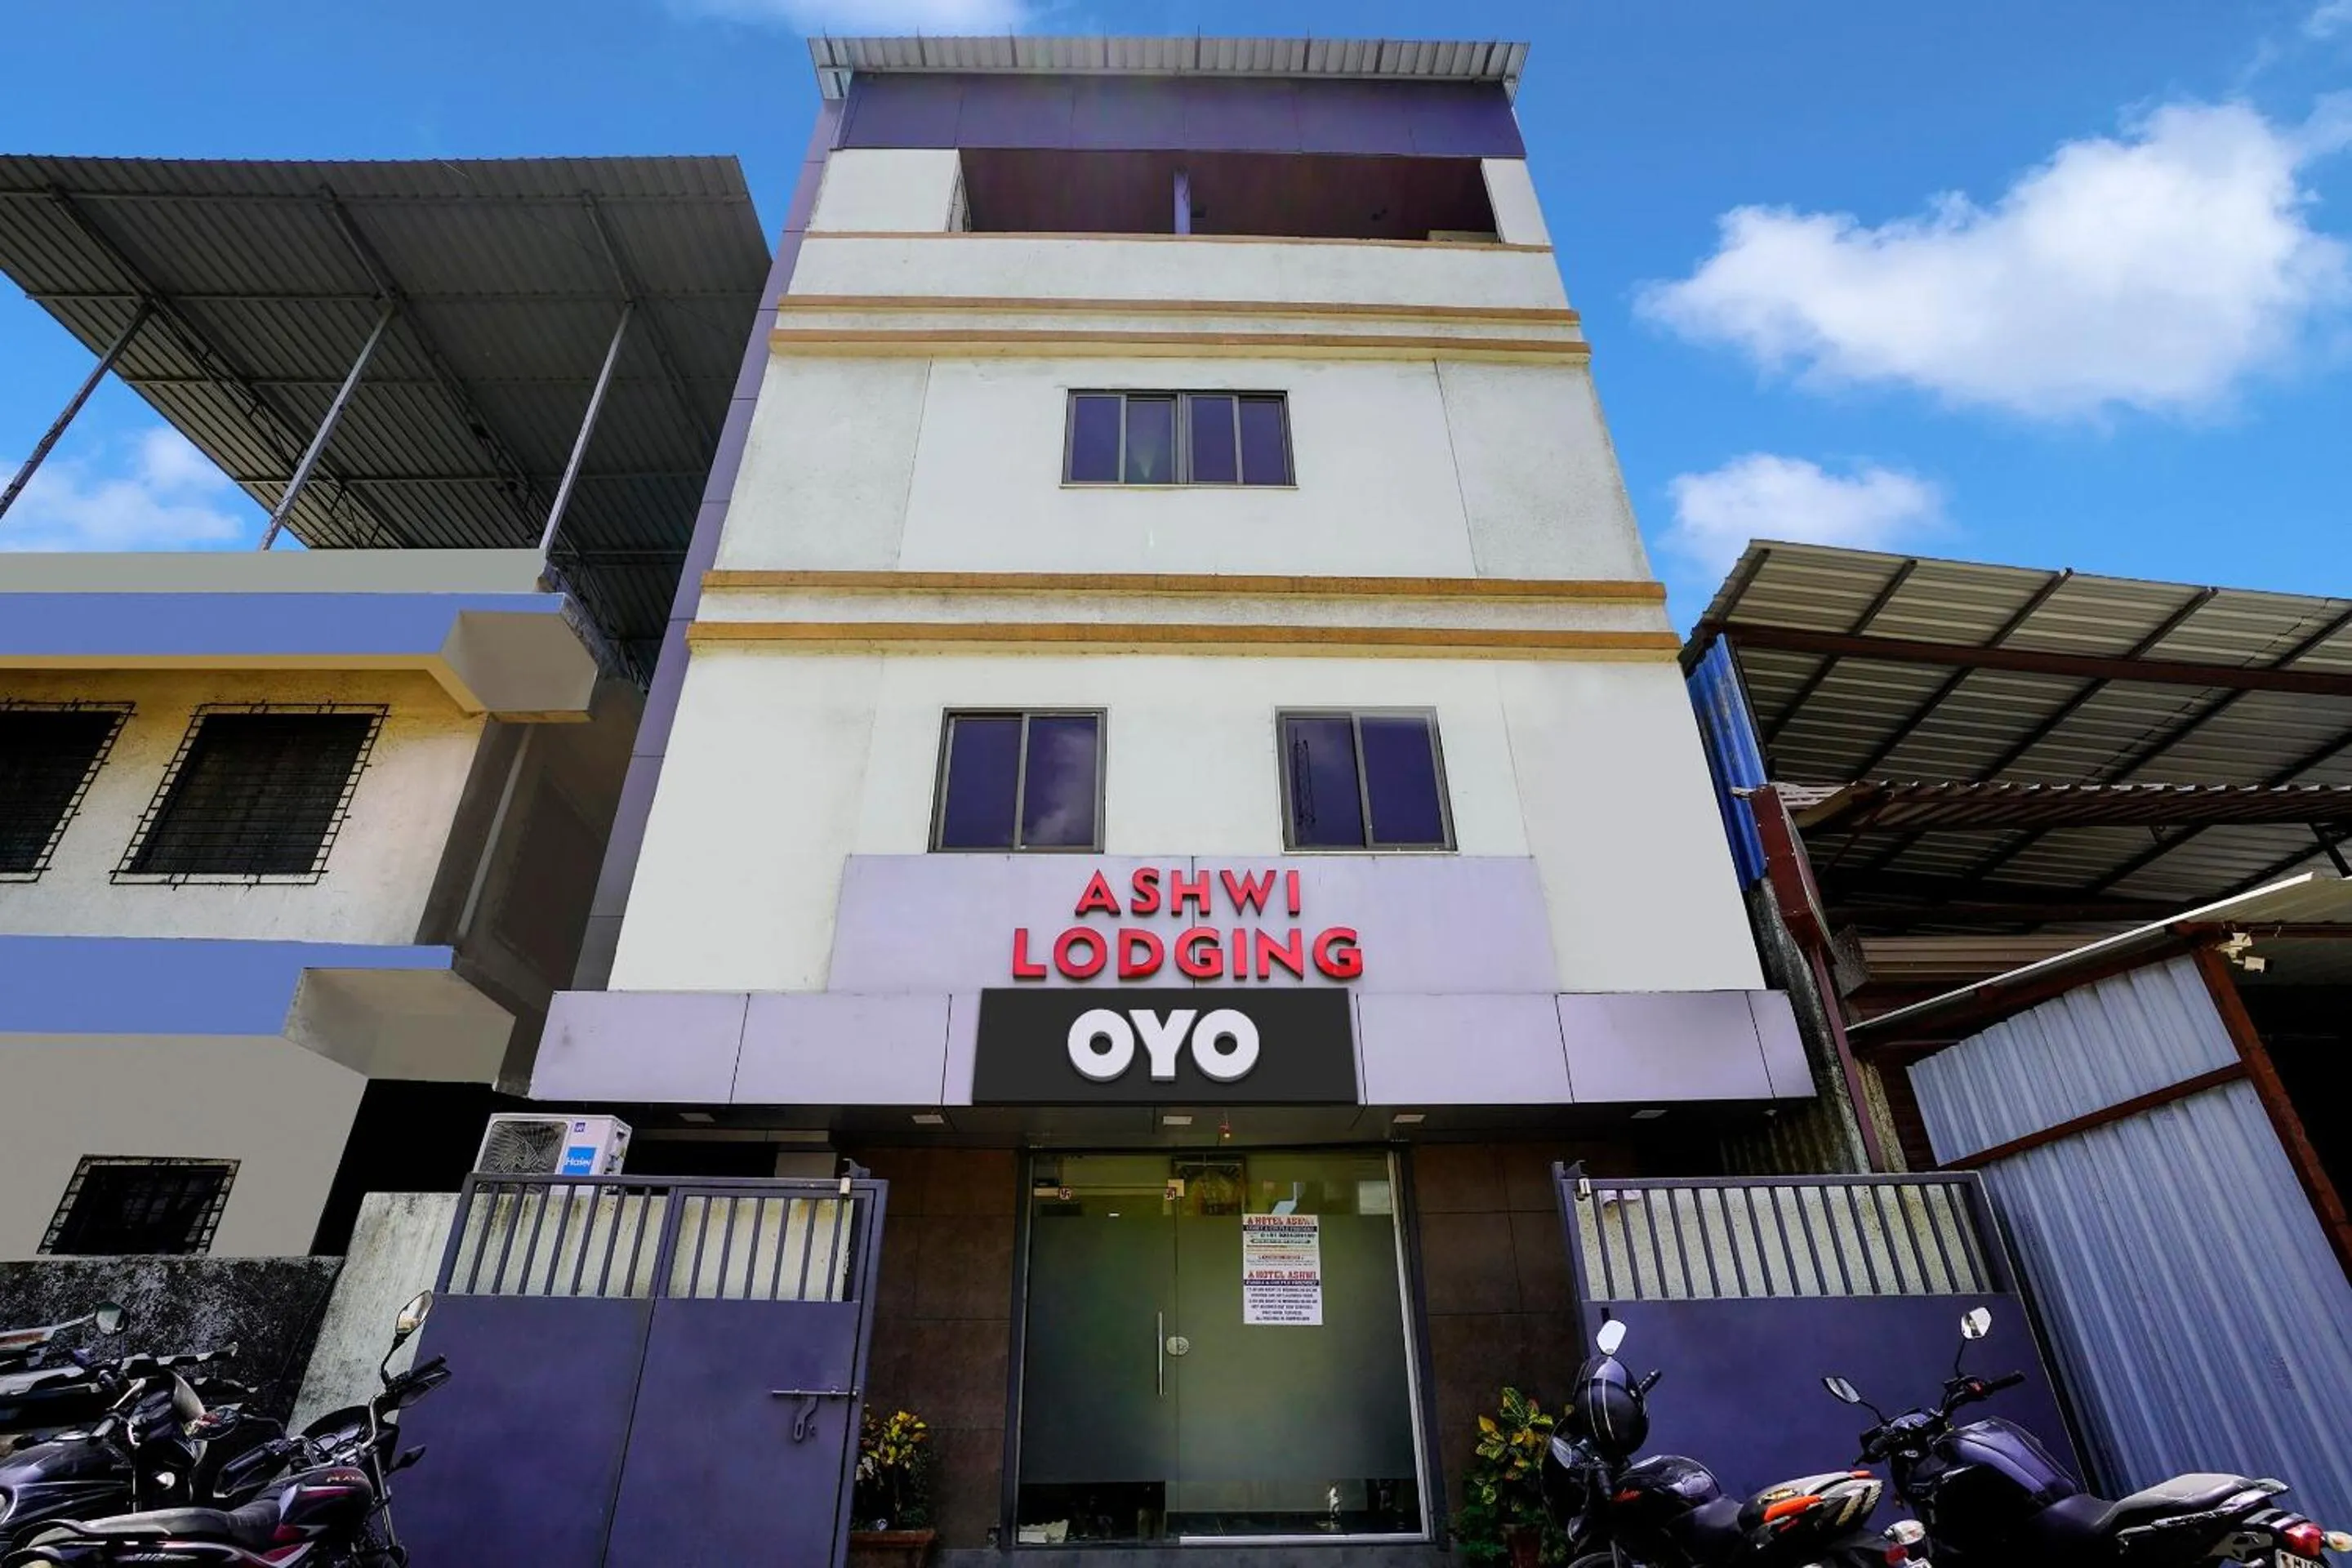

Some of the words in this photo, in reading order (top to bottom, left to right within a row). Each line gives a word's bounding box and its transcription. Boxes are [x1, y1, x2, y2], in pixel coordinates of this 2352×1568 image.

[1075, 868, 1301, 916] ASHWI
[1013, 927, 1363, 979] LODGING
[1067, 1008, 1259, 1082] OYO
[564, 1156, 593, 1167] Haier
